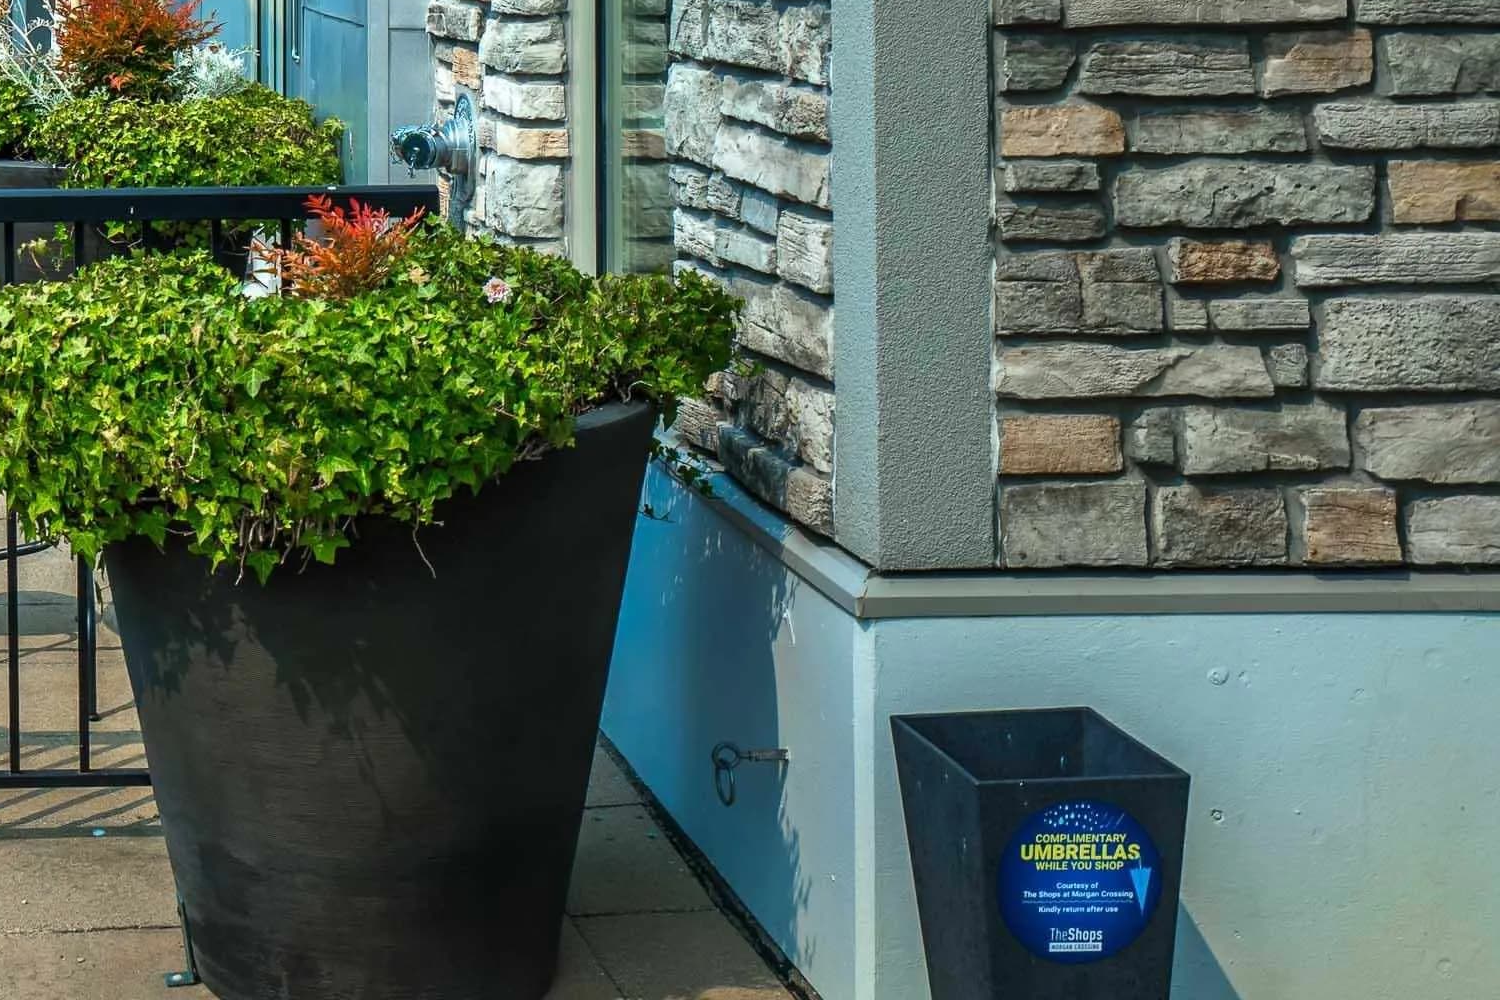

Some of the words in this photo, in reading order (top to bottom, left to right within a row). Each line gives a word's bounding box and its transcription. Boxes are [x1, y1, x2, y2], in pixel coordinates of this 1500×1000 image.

[1035, 833, 1126, 843] COMPLIMENTARY
[1020, 844, 1141, 861] UMBRELLAS
[1035, 861, 1069, 871] WHILE
[1070, 861, 1092, 870] YOU
[1094, 861, 1124, 870] SHOP
[1056, 882, 1089, 891] Courtesy
[1038, 890, 1061, 899] Shops
[1071, 890, 1100, 899] Morgan
[1101, 890, 1134, 899] Crossing
[1038, 906, 1061, 915] Kindly
[1086, 905, 1104, 913] after
